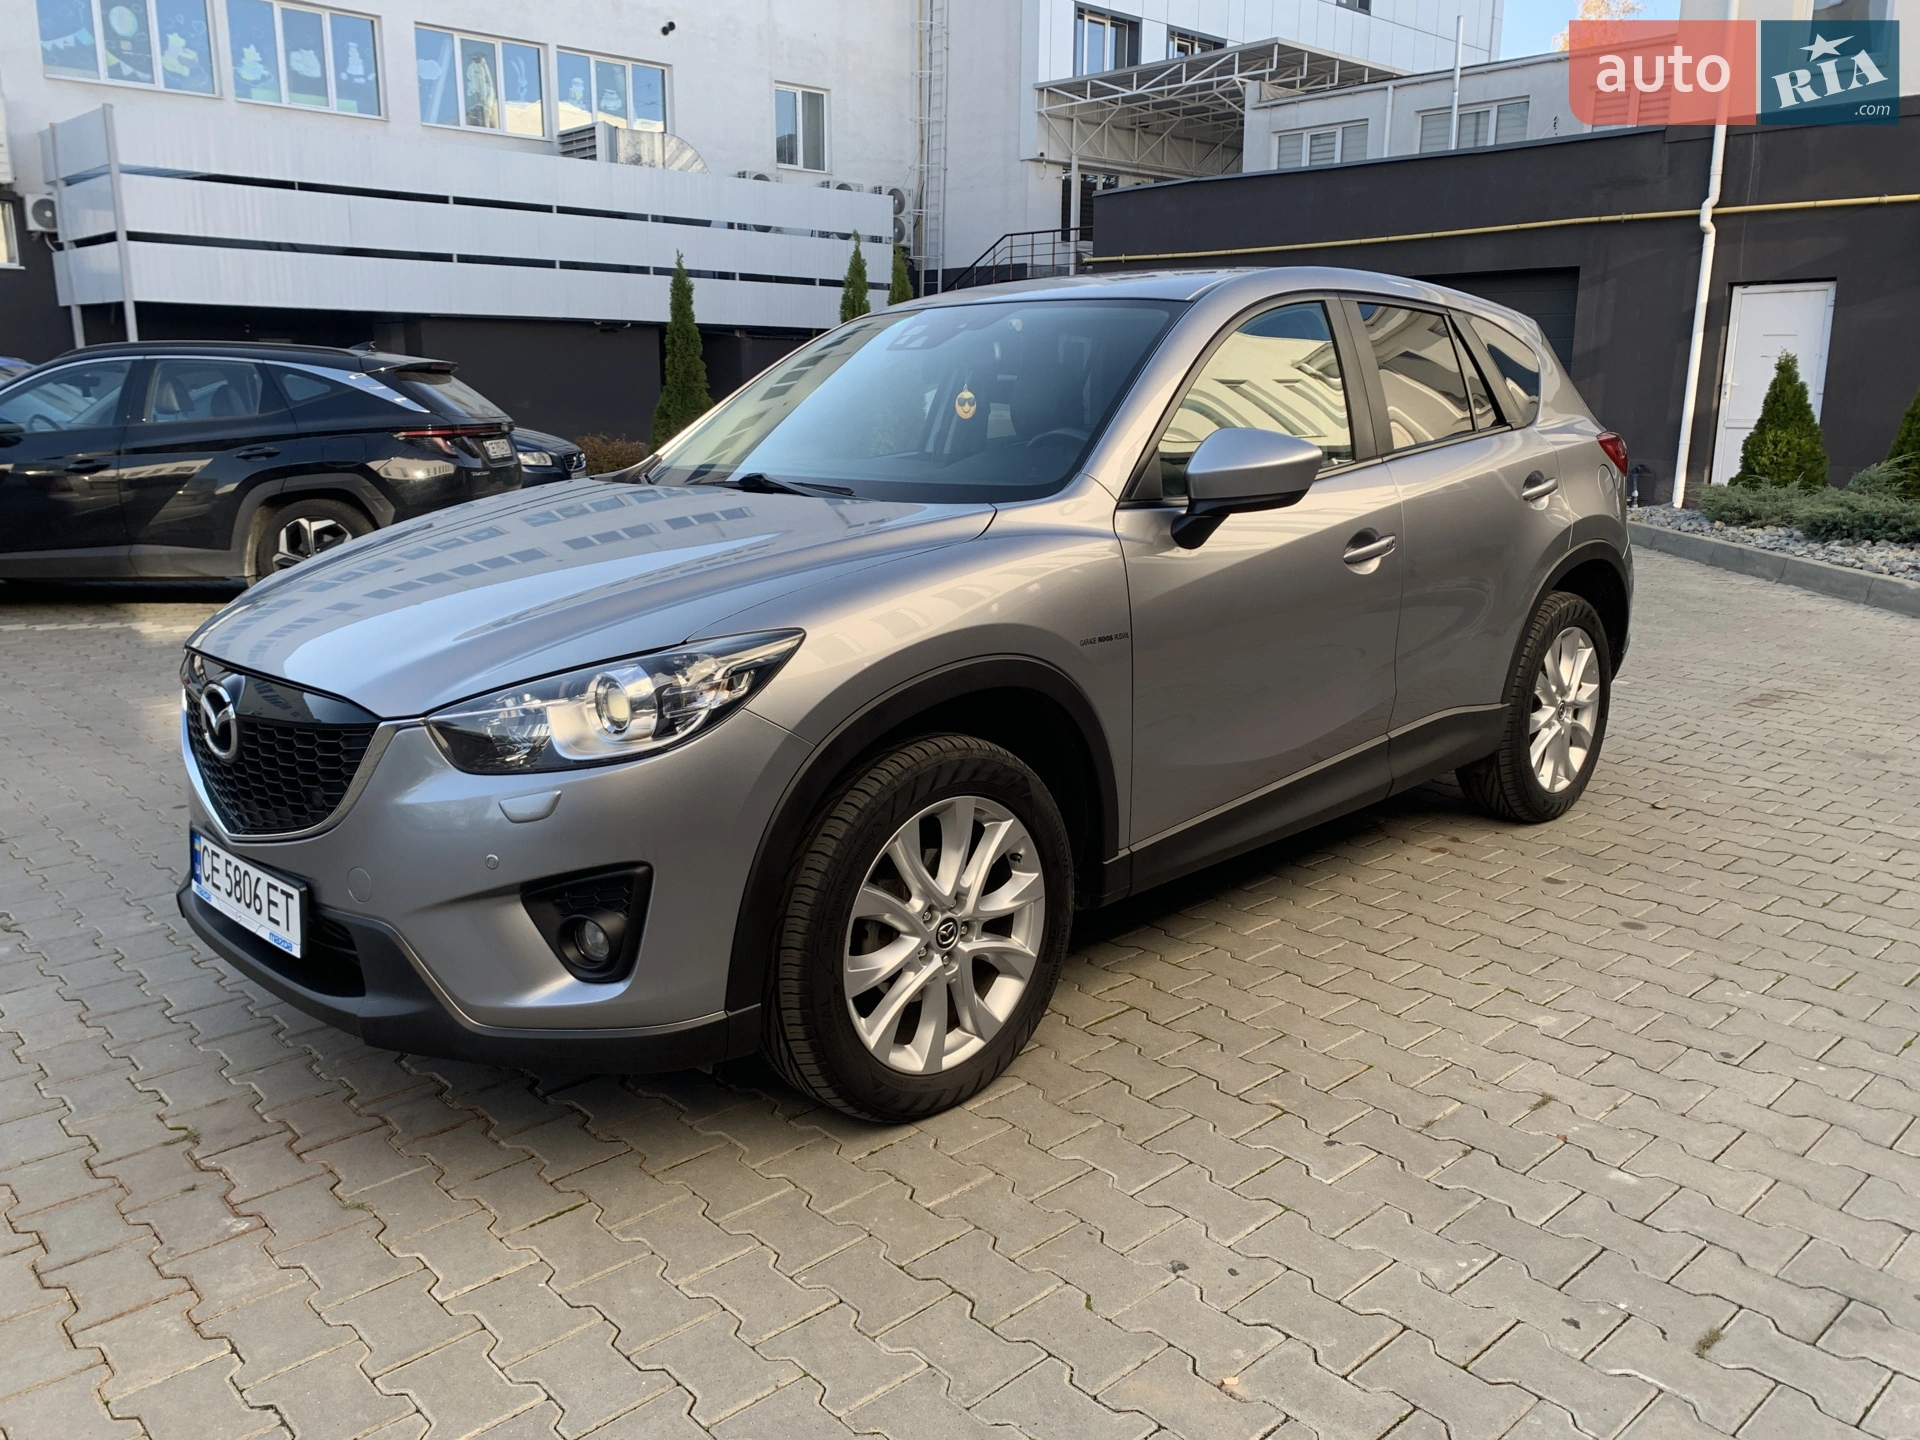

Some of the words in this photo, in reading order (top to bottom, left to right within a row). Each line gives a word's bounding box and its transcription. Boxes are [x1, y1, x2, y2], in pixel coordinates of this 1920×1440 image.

[1097, 634, 1114, 644] ROOS
[201, 844, 222, 892] CE
[224, 858, 263, 916] 5806
[266, 881, 295, 932] ET
[832, 888, 845, 912] Skin
[842, 831, 875, 885] Technology
[268, 931, 293, 953] mazda
